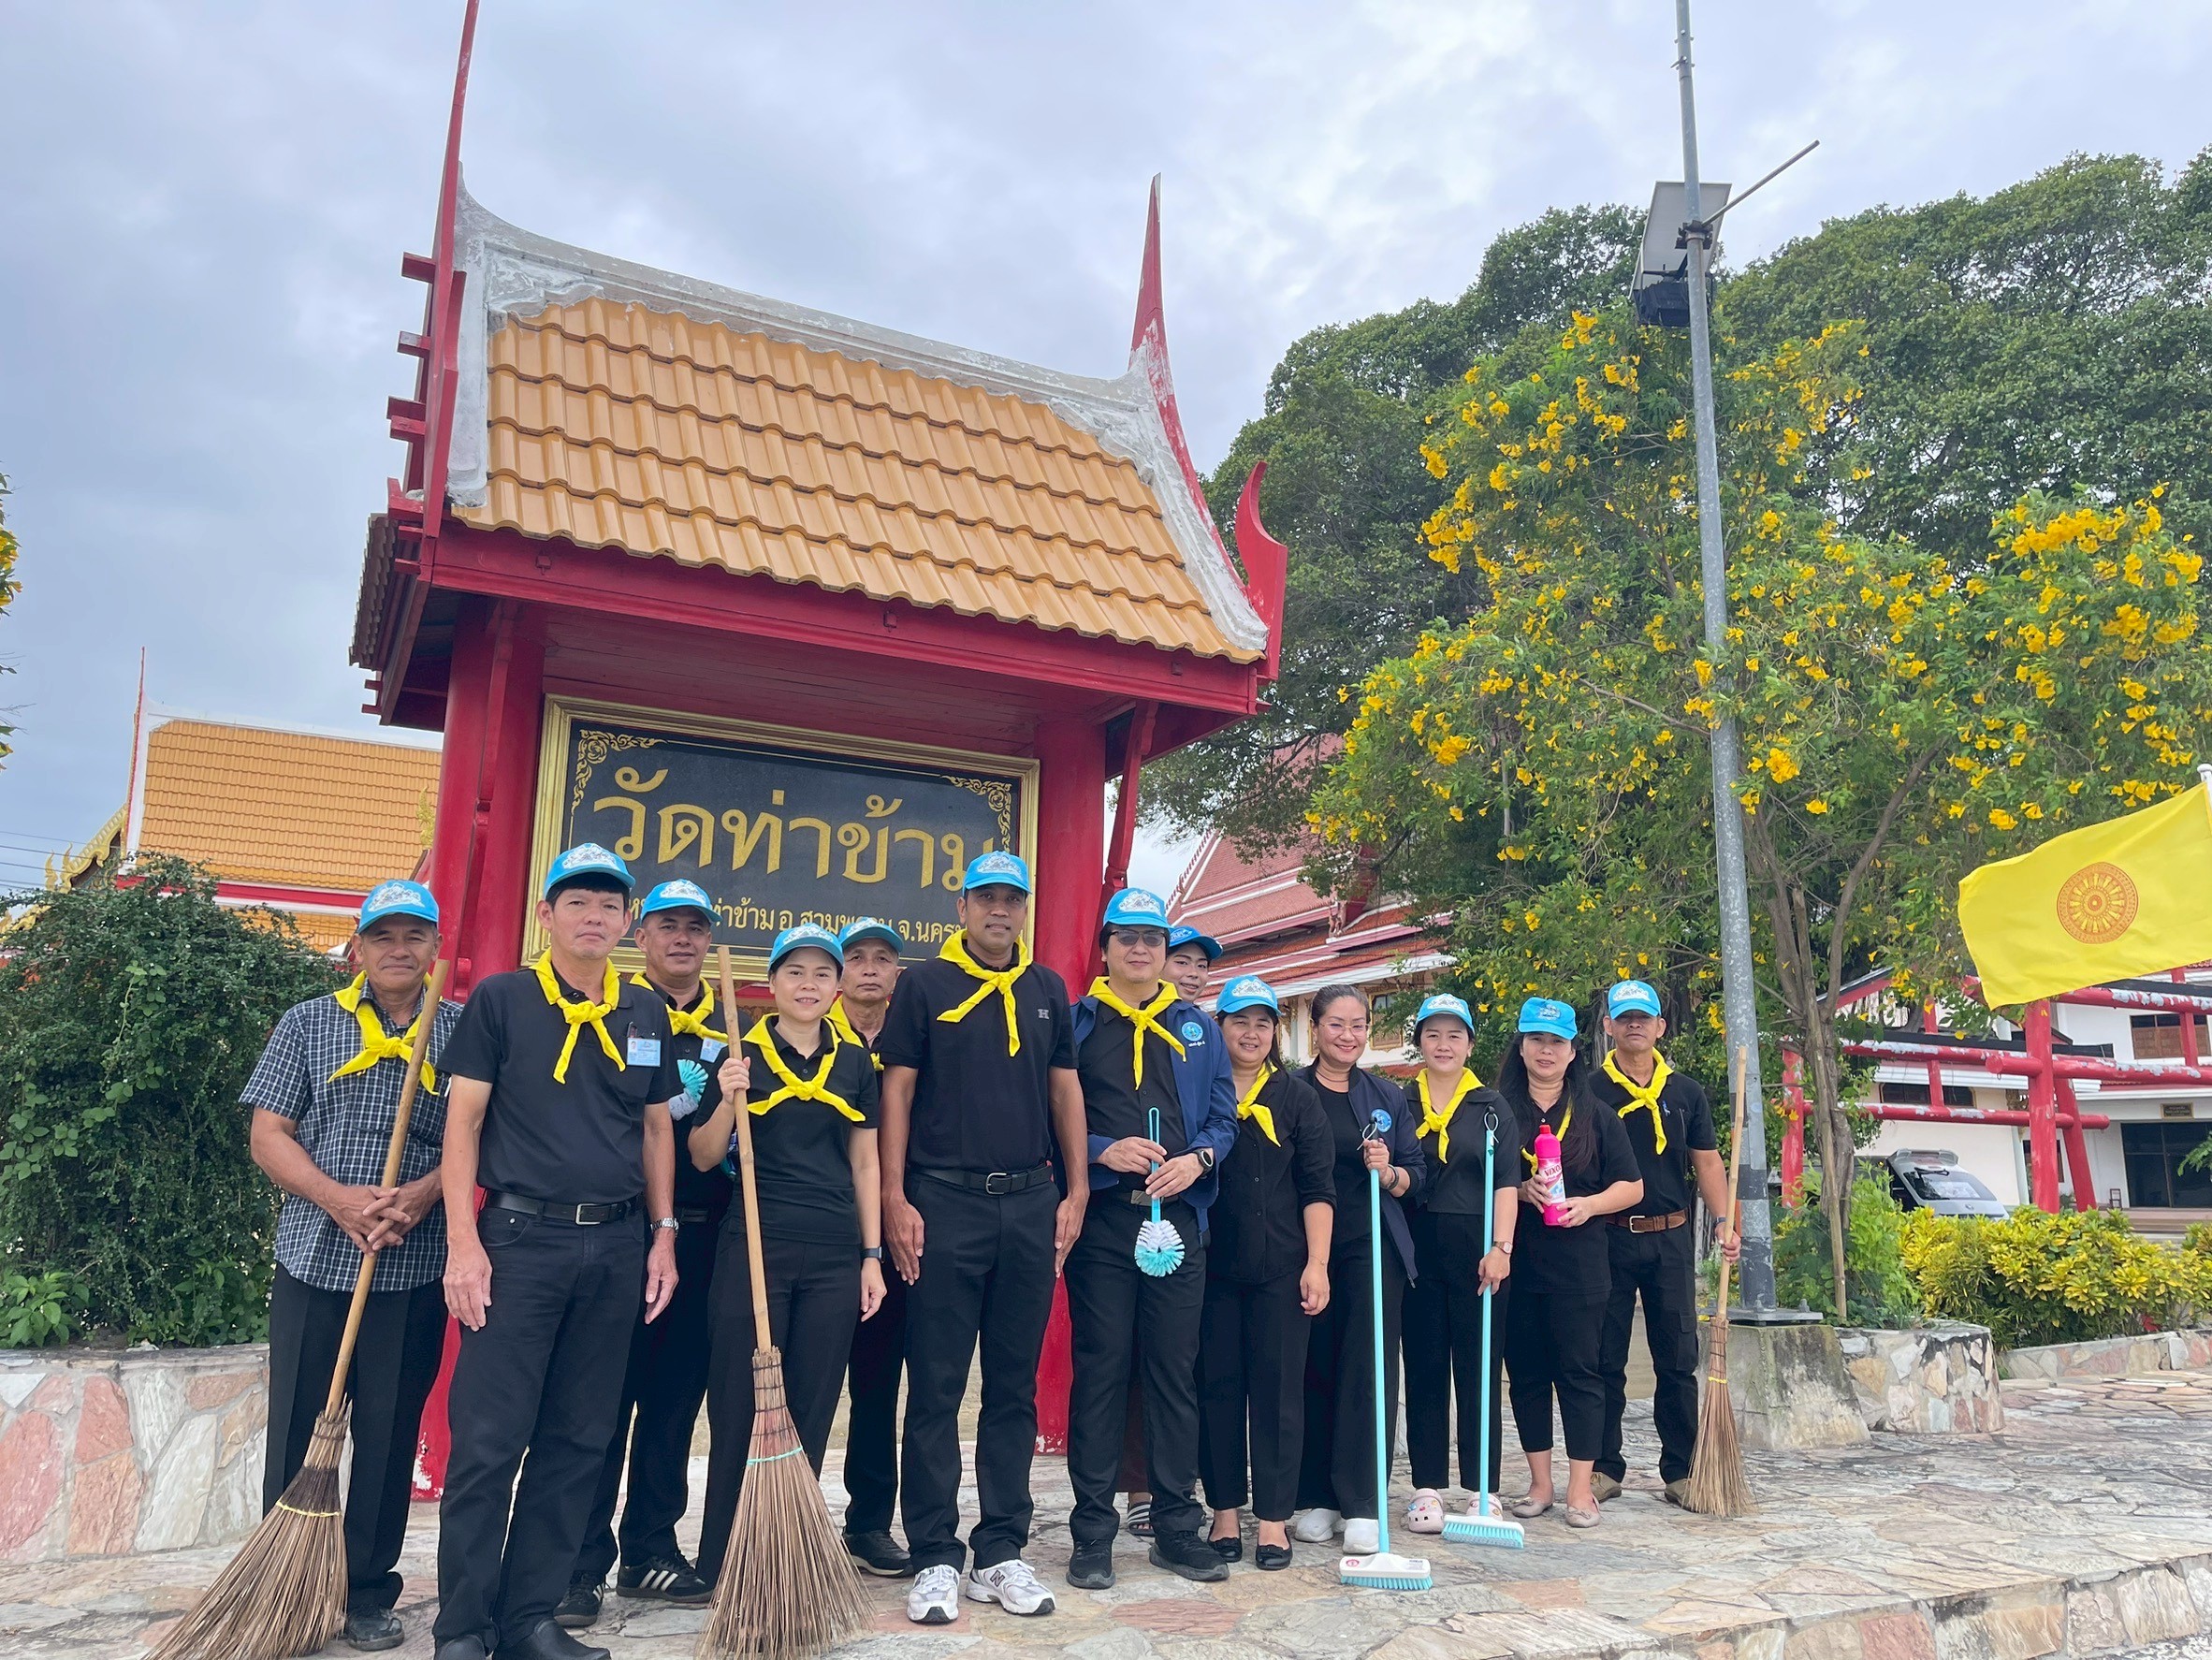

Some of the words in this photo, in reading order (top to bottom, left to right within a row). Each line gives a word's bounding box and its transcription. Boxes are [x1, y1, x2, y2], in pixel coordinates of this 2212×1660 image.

[593, 766, 995, 892] วัดท่าข้าม
[989, 1569, 1006, 1588] N
